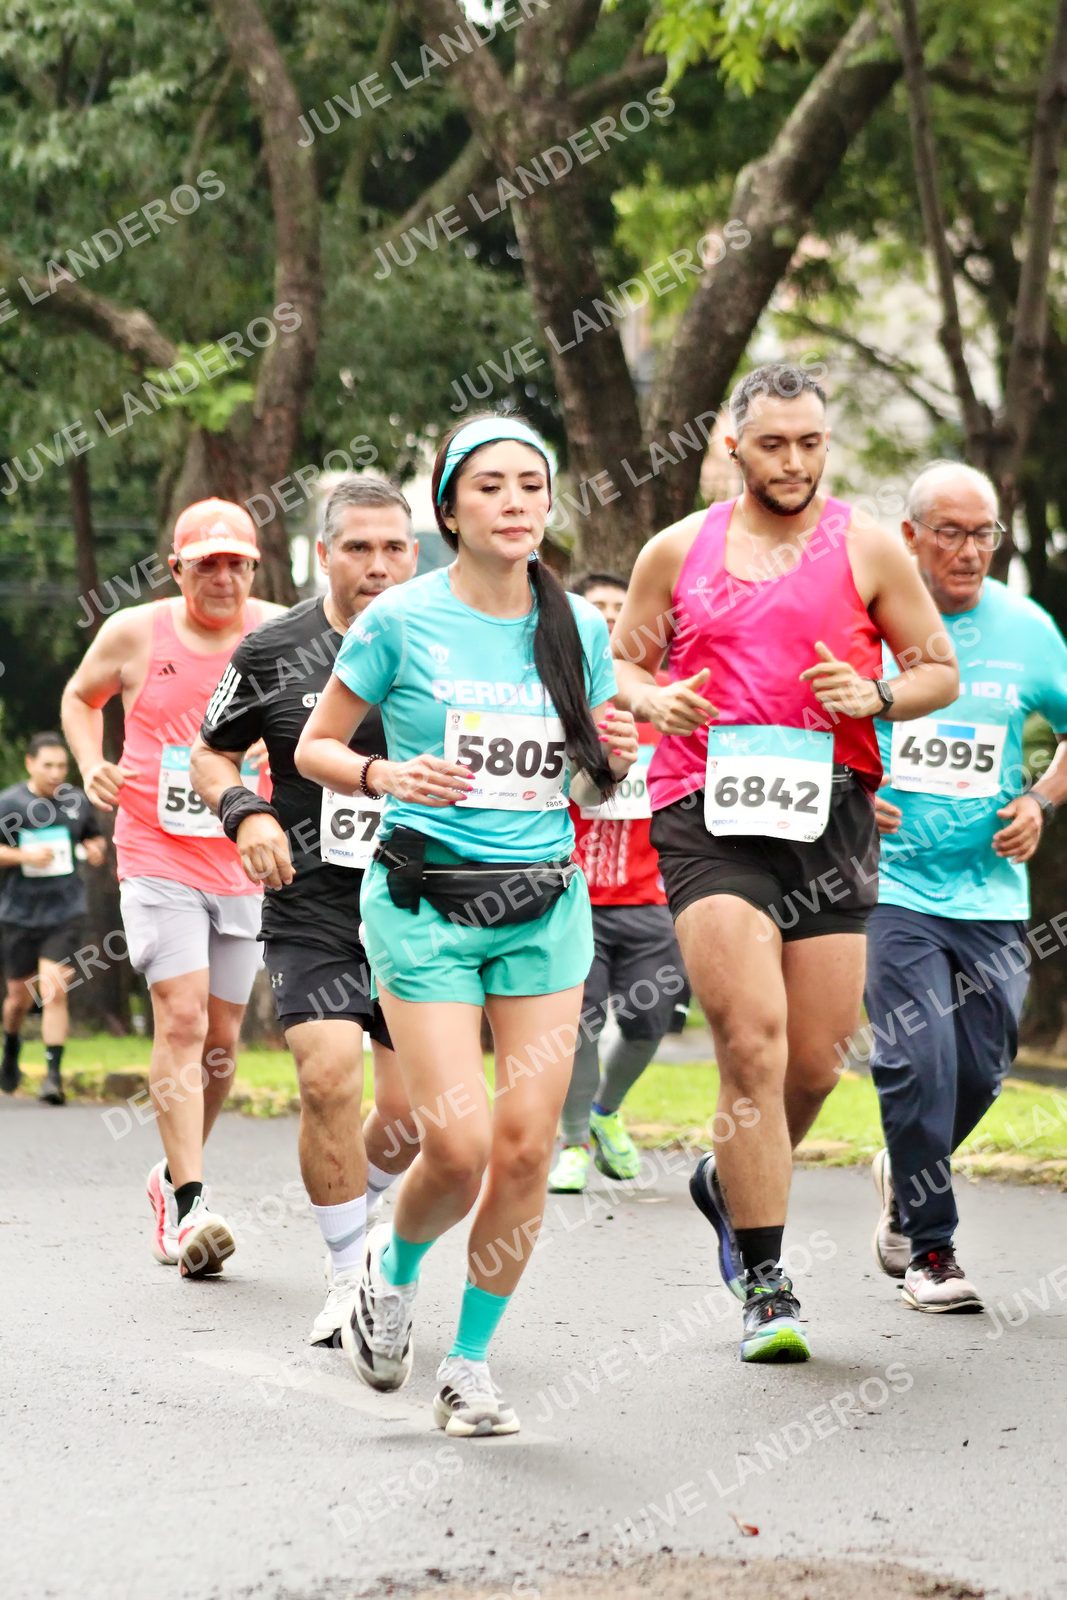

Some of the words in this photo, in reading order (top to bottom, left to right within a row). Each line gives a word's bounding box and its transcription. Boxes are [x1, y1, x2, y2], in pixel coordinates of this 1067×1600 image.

[456, 734, 566, 779] 5805
[899, 735, 996, 774] 4995
[164, 786, 216, 817] 59
[714, 775, 820, 815] 6842
